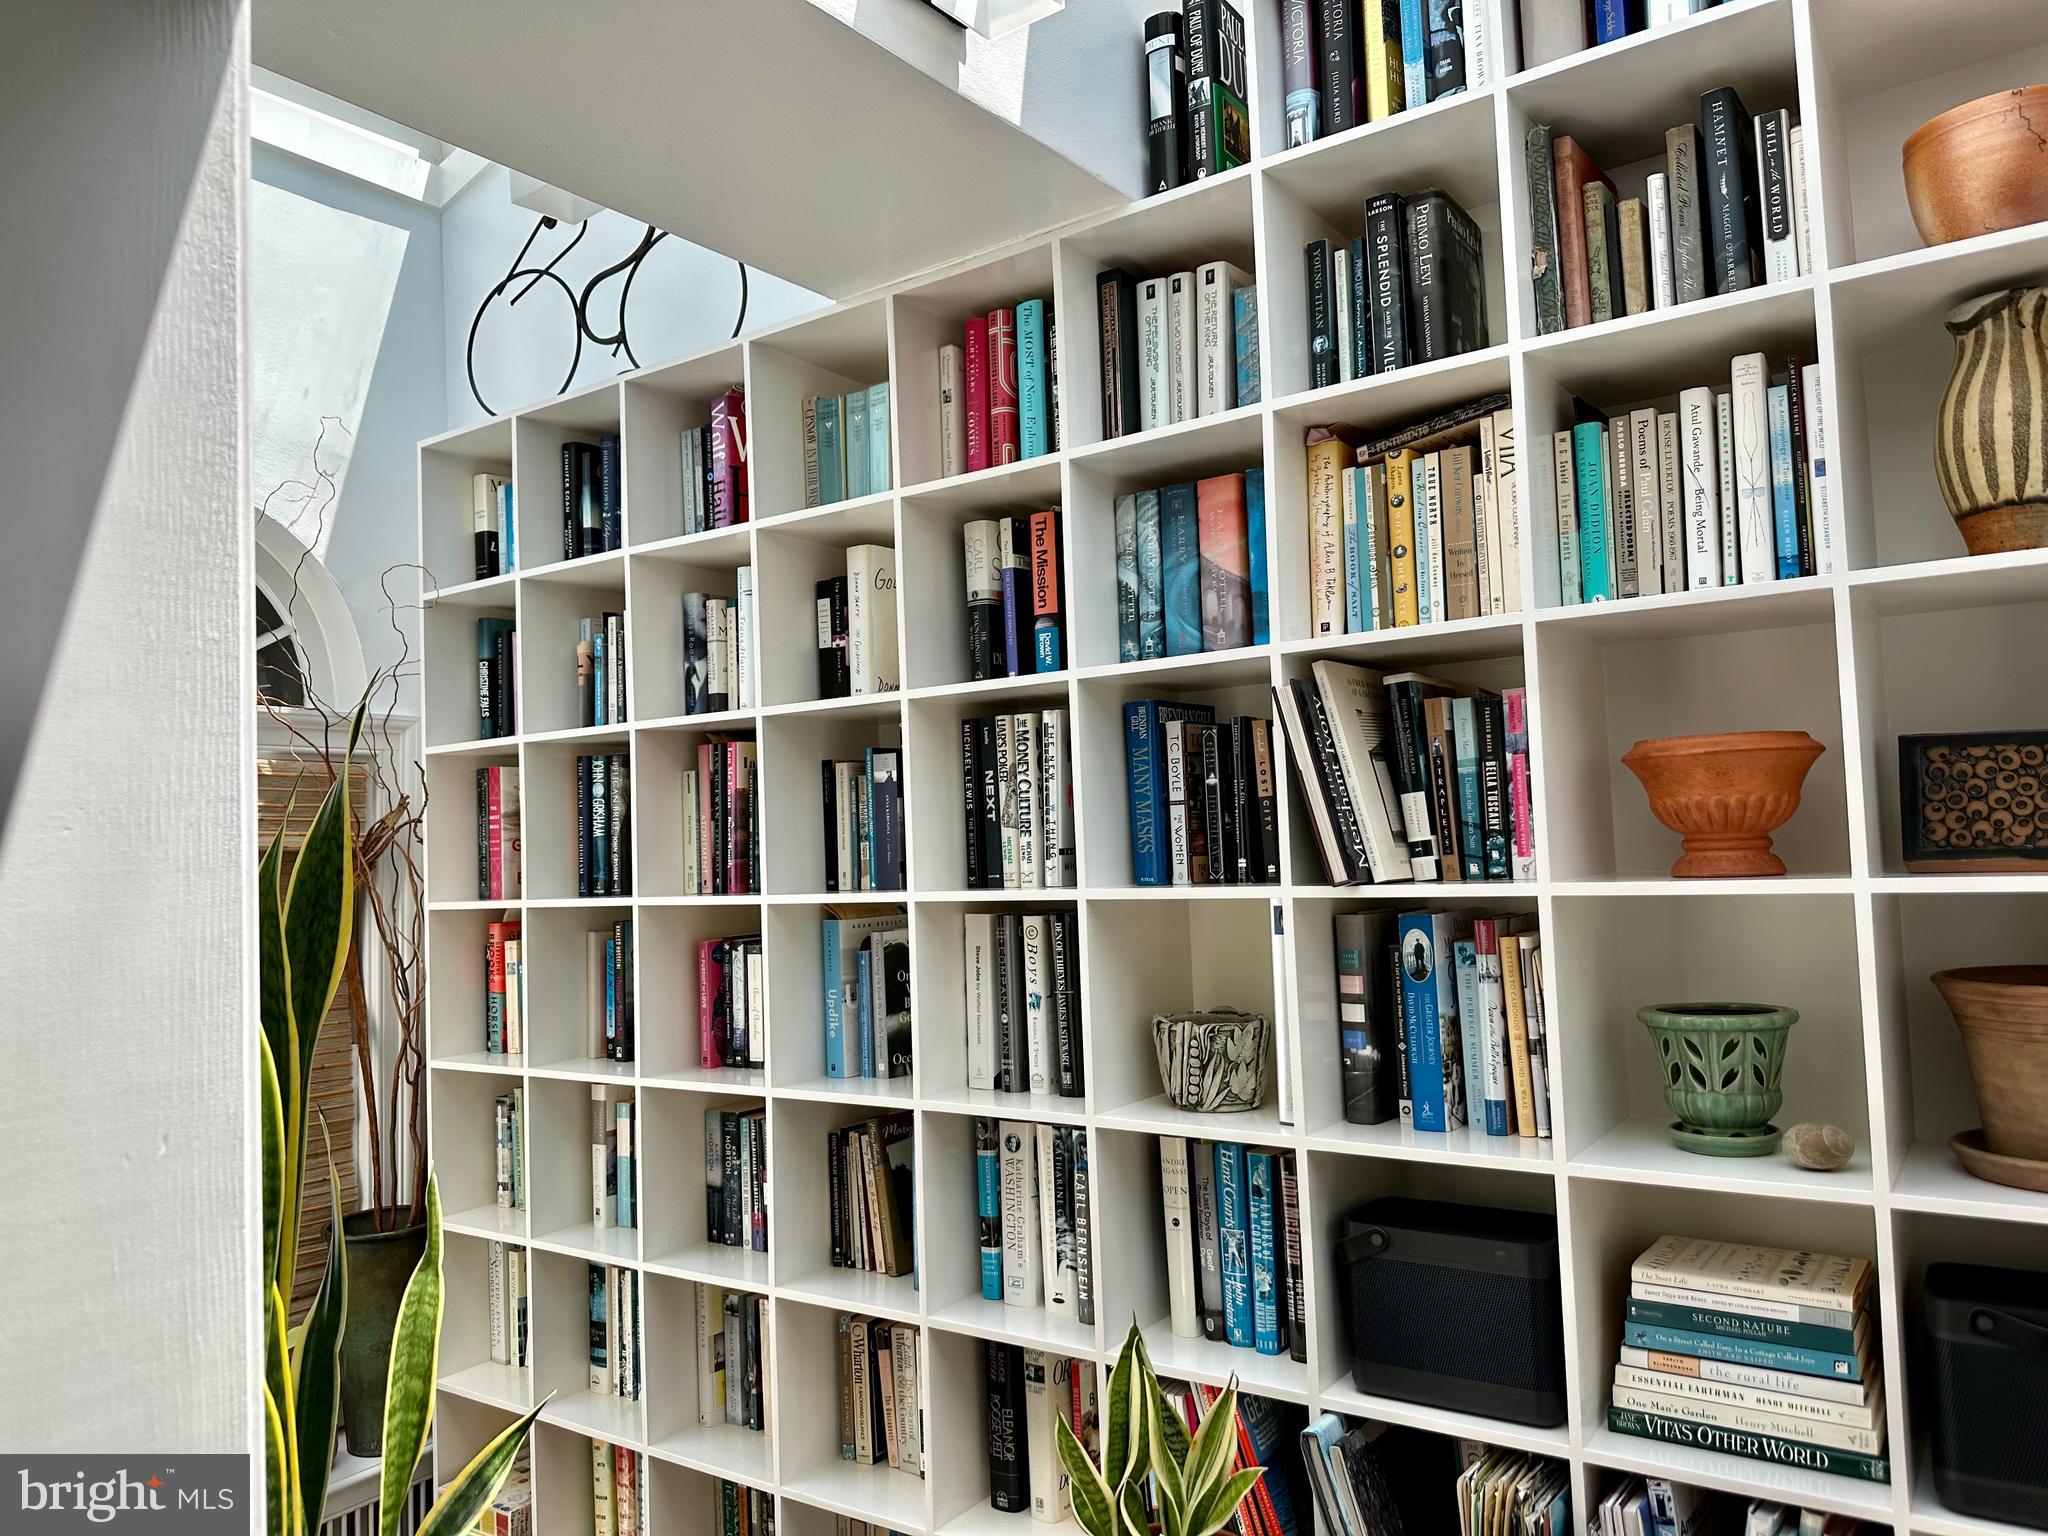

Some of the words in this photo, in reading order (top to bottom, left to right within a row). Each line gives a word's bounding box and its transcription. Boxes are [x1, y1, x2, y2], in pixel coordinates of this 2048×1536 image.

[1189, 10, 1202, 35] PAUL
[1220, 3, 1245, 53] PAUL
[1190, 34, 1202, 47] OF
[1191, 48, 1204, 76] DUNE
[1331, 71, 1339, 95] JULIA
[1333, 98, 1341, 123] BAIRD
[1711, 100, 1728, 166] HAMNET
[1368, 205, 1393, 217] LARSON
[1373, 199, 1387, 208] ERIK
[1416, 203, 1430, 250] PRIMO
[1313, 249, 1322, 290] YOUNG
[1419, 253, 1433, 287] LEVI
[1023, 304, 1033, 326] The
[1315, 292, 1324, 329] TITAN
[1024, 330, 1034, 367] MOST
[1024, 370, 1034, 381] of
[1025, 384, 1036, 411] Nora
[1690, 404, 1702, 425] Atul
[712, 401, 726, 460] Wolf
[1617, 421, 1625, 449] PABLO
[1637, 419, 1649, 455] Poems
[1639, 459, 1651, 470] of
[1691, 427, 1704, 473] Gawande
[1427, 467, 1437, 490] TRUE
[1588, 462, 1600, 496] JOAN
[1618, 451, 1627, 487] NERUDA
[1640, 472, 1653, 497] Paul
[714, 479, 727, 524] Hall
[1429, 495, 1438, 526] NORTH
[1561, 494, 1570, 509] The
[1641, 500, 1653, 533] Celan
[1692, 488, 1705, 518] Being
[1035, 517, 1047, 547] The
[1561, 514, 1571, 561] Emigrants
[1590, 503, 1602, 554] DIDION
[1695, 519, 1708, 554] Mortal
[966, 536, 975, 577] SAGAN
[973, 539, 983, 574] CARL
[1036, 549, 1049, 609] Mission
[1045, 655, 1052, 666] W.
[479, 661, 490, 697] CHRISTINE
[481, 697, 490, 718] FALLS
[1017, 718, 1028, 731] THE
[1131, 715, 1139, 732] GILL
[1138, 706, 1148, 740] BRENDAN
[997, 718, 1008, 749] LIAR'S
[1312, 695, 1337, 760] Ivory
[963, 725, 972, 771] MICHAEL
[1016, 730, 1030, 777] MONEY
[592, 760, 604, 782] JOHN
[998, 750, 1009, 783] POKER
[1133, 748, 1151, 797] MANY
[1171, 758, 1181, 793] BOYLE
[1260, 760, 1268, 793] LOST
[1485, 761, 1498, 787] BELLA
[965, 776, 973, 810] LEWIS
[984, 770, 996, 822] NEXT
[1464, 777, 1474, 798] Under
[593, 798, 605, 837] GRISHAM
[1018, 779, 1032, 838] CULTURE
[1263, 800, 1272, 832] CITY
[1332, 762, 1369, 869] Merchant
[1466, 800, 1474, 810] the
[1487, 790, 1500, 831] TUSCANY
[1136, 801, 1154, 854] MASKS
[1467, 812, 1476, 834] Tuscan
[1055, 941, 1064, 955] OF
[1505, 946, 1514, 979] LETTERS
[998, 947, 1007, 1013] COMPANY
[1056, 955, 1066, 991] THIEVES
[1465, 973, 1473, 990] THE
[1509, 980, 1515, 991] TO
[491, 996, 499, 1037] HORSE
[828, 989, 839, 1039] Updike
[1058, 994, 1067, 1020] JAMES
[1425, 1004, 1434, 1034] GREATER
[1466, 996, 1476, 1037] PERFECT
[1510, 991, 1520, 1030] CAMONDO
[1060, 1030, 1070, 1066] STEWART
[1426, 1035, 1436, 1066] JOURNEY
[1470, 1040, 1479, 1080] SUMMER
[1515, 1044, 1525, 1077] EDMUND
[1221, 1150, 1237, 1185] Hard
[1015, 1159, 1023, 1213] Katharine
[1075, 1173, 1086, 1209] CARL
[1164, 1185, 1187, 1195] OPEN
[1005, 1157, 1017, 1253] WASHINGTON
[1202, 1211, 1211, 1231] Days
[1223, 1188, 1237, 1229] Courts
[1017, 1216, 1026, 1268] Graham's
[1205, 1232, 1212, 1241] of
[1260, 1204, 1272, 1247] LADIES
[1077, 1217, 1088, 1300] BERNSTEIN
[1206, 1249, 1215, 1272] Geoff
[1263, 1249, 1274, 1261] of
[1224, 1277, 1238, 1327] Feinstein
[1234, 1280, 1247, 1306] John
[1691, 1312, 1739, 1327] SECOND
[1742, 1321, 1790, 1336] NATURE
[895, 1333, 904, 1372] Wharton
[903, 1344, 911, 1369] Edith
[1632, 1373, 1685, 1391] ESSENTIAL
[1688, 1382, 1745, 1401] EARTHMAN
[1756, 1396, 1783, 1408] HENRY
[1788, 1401, 1831, 1416] MITCHELL
[1709, 1365, 1731, 1379] the
[1737, 1370, 1770, 1386] rural
[1776, 1376, 1800, 1391] life
[990, 1394, 1003, 1461] ROOSEVELT
[1616, 1419, 1641, 1430] BROWN
[1627, 1396, 1647, 1408] One
[1650, 1400, 1678, 1414] Man's
[1682, 1406, 1718, 1421] Garden
[1735, 1415, 1767, 1432] Henry
[1770, 1422, 1814, 1438] Mitchell
[1001, 1408, 1014, 1461] ELEANOR
[1644, 1415, 1693, 1441] VITA'S
[1696, 1426, 1759, 1455] OTHER
[1761, 1440, 1829, 1468] WORLD
